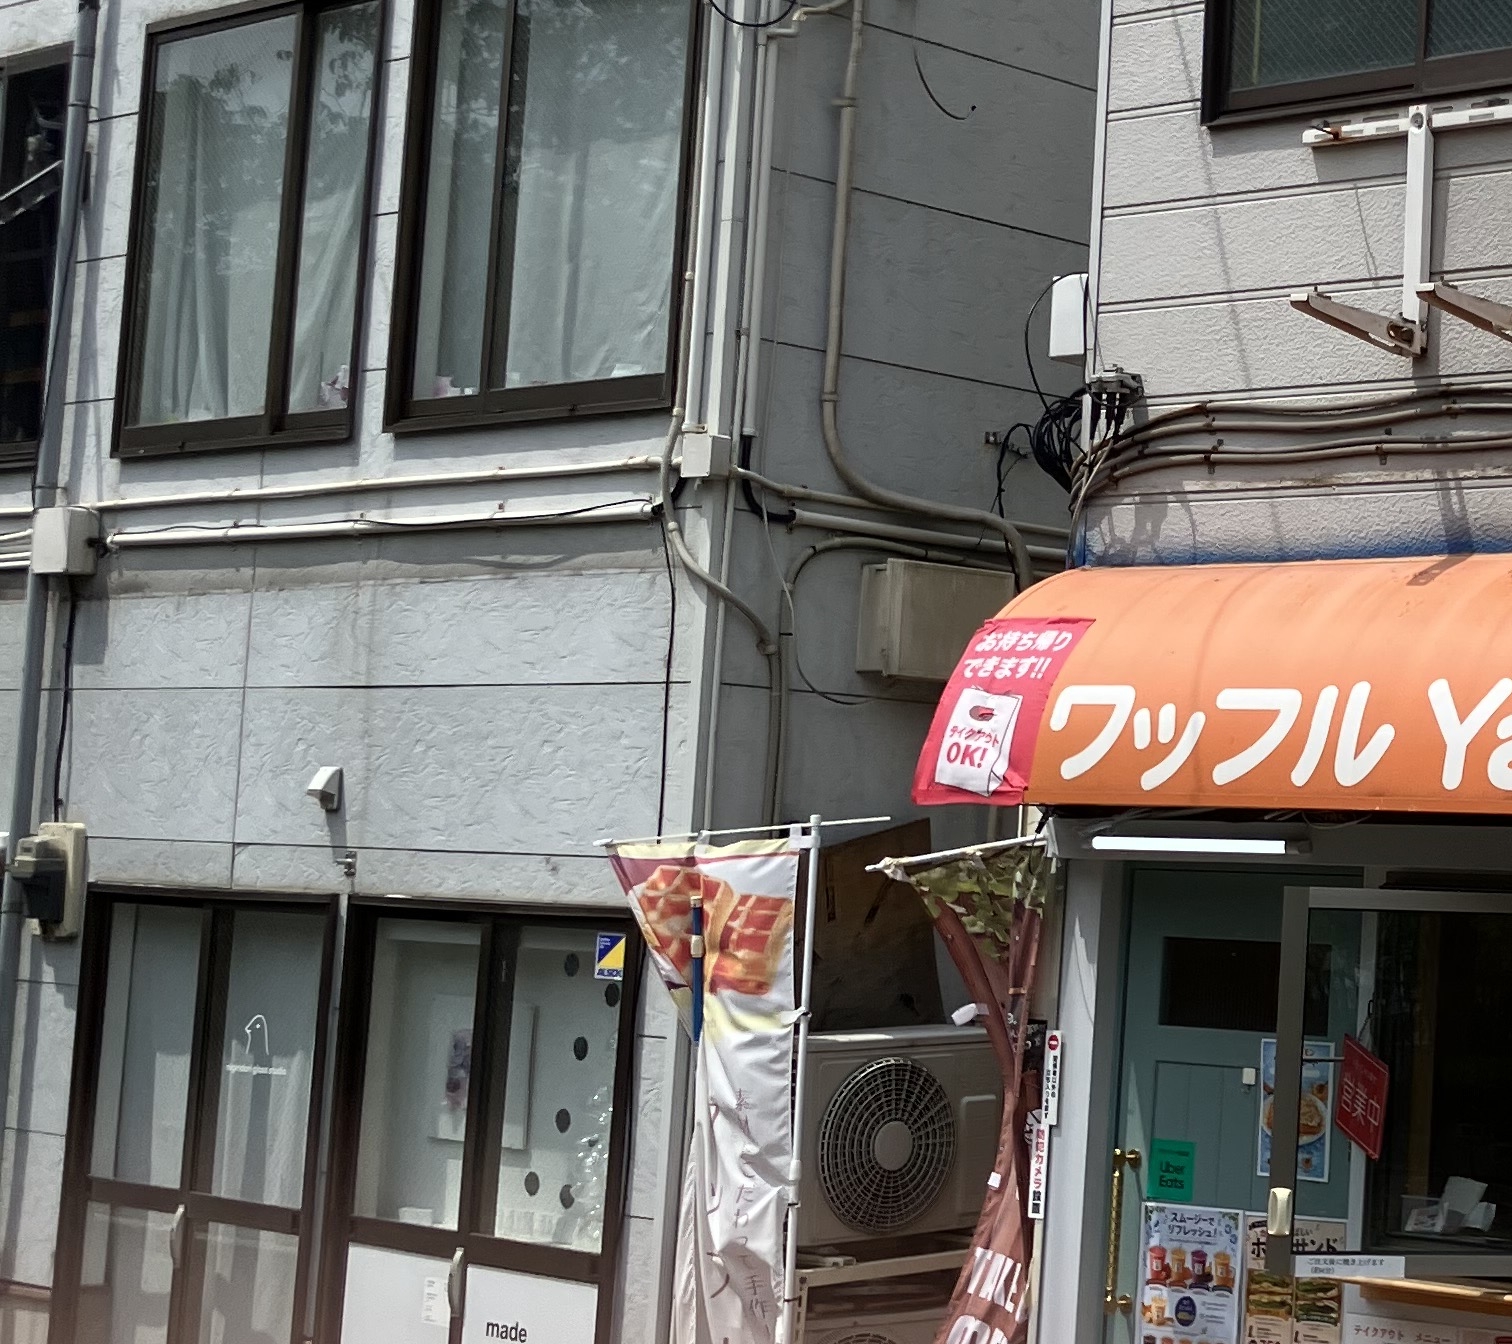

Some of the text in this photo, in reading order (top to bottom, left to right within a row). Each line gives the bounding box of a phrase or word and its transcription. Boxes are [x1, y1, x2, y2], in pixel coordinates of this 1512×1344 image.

[975, 630, 1073, 652] お持ち帰り
[949, 725, 999, 748] テイクアウト
[1050, 680, 1395, 791] ワッフル
[946, 742, 988, 768] OK!
[1341, 1075, 1380, 1131] 営業中
[486, 1321, 527, 1343] made
